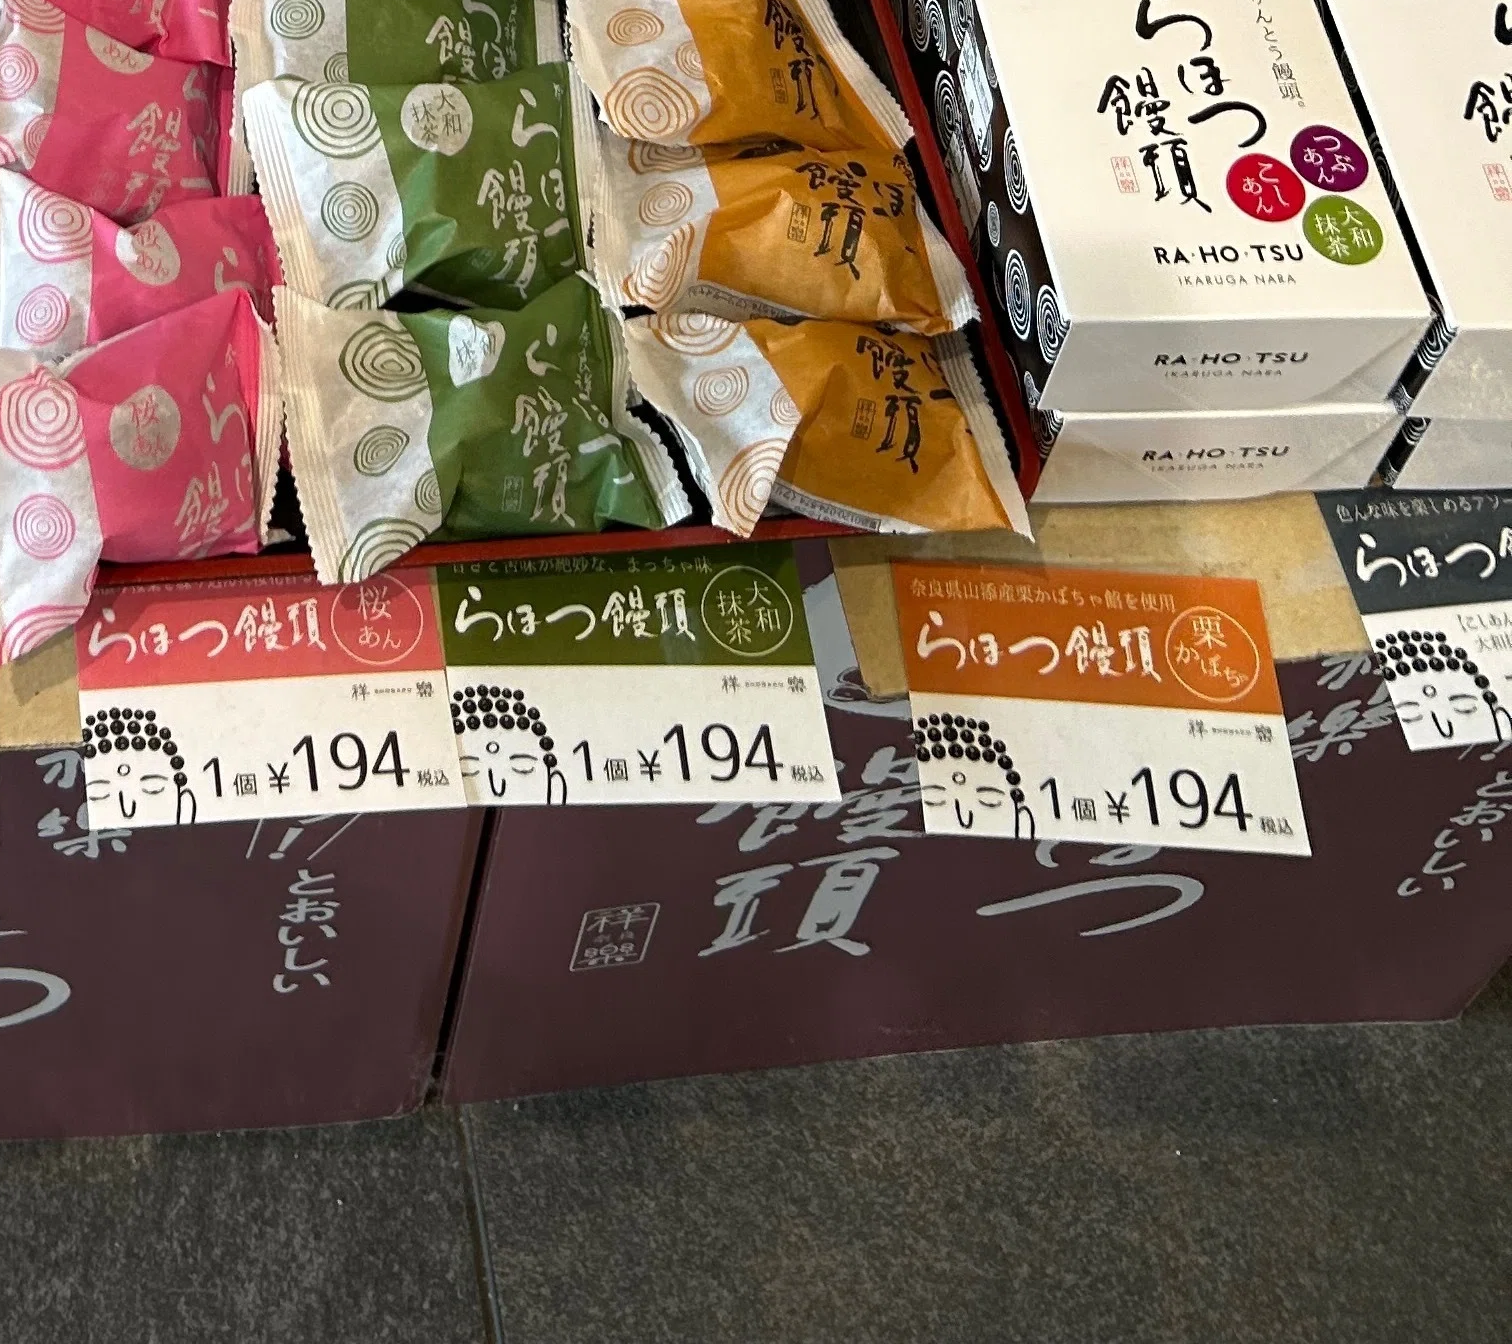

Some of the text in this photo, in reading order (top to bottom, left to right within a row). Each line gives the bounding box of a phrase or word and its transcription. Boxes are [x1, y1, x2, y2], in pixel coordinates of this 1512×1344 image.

[1096, 65, 1213, 214] 饅頭
[1301, 148, 1335, 186] あん
[1325, 134, 1357, 176] つぶ
[1240, 175, 1273, 215] あん
[1257, 162, 1291, 208] こし
[475, 159, 541, 301] 饅頭
[1313, 211, 1349, 259] 抹茶
[1339, 204, 1376, 251] 大和
[1177, 271, 1297, 288] IKARUGA NARA
[510, 385, 577, 529] 饅頭
[356, 584, 393, 622] 桜
[454, 584, 697, 643] らほつ饅頭
[715, 589, 753, 646] 抹茶
[745, 579, 782, 634] 大和
[87, 597, 327, 665] らほつ饅頭
[357, 625, 402, 650] あん
[916, 610, 1163, 683] らほつ饅頭
[1190, 613, 1229, 650] 栗
[202, 756, 259, 799] 1個
[266, 728, 412, 794] ¥194
[572, 738, 630, 783] 1個
[637, 723, 785, 783] ¥194
[1039, 777, 1098, 823] 1個
[1104, 766, 1255, 833] ¥194
